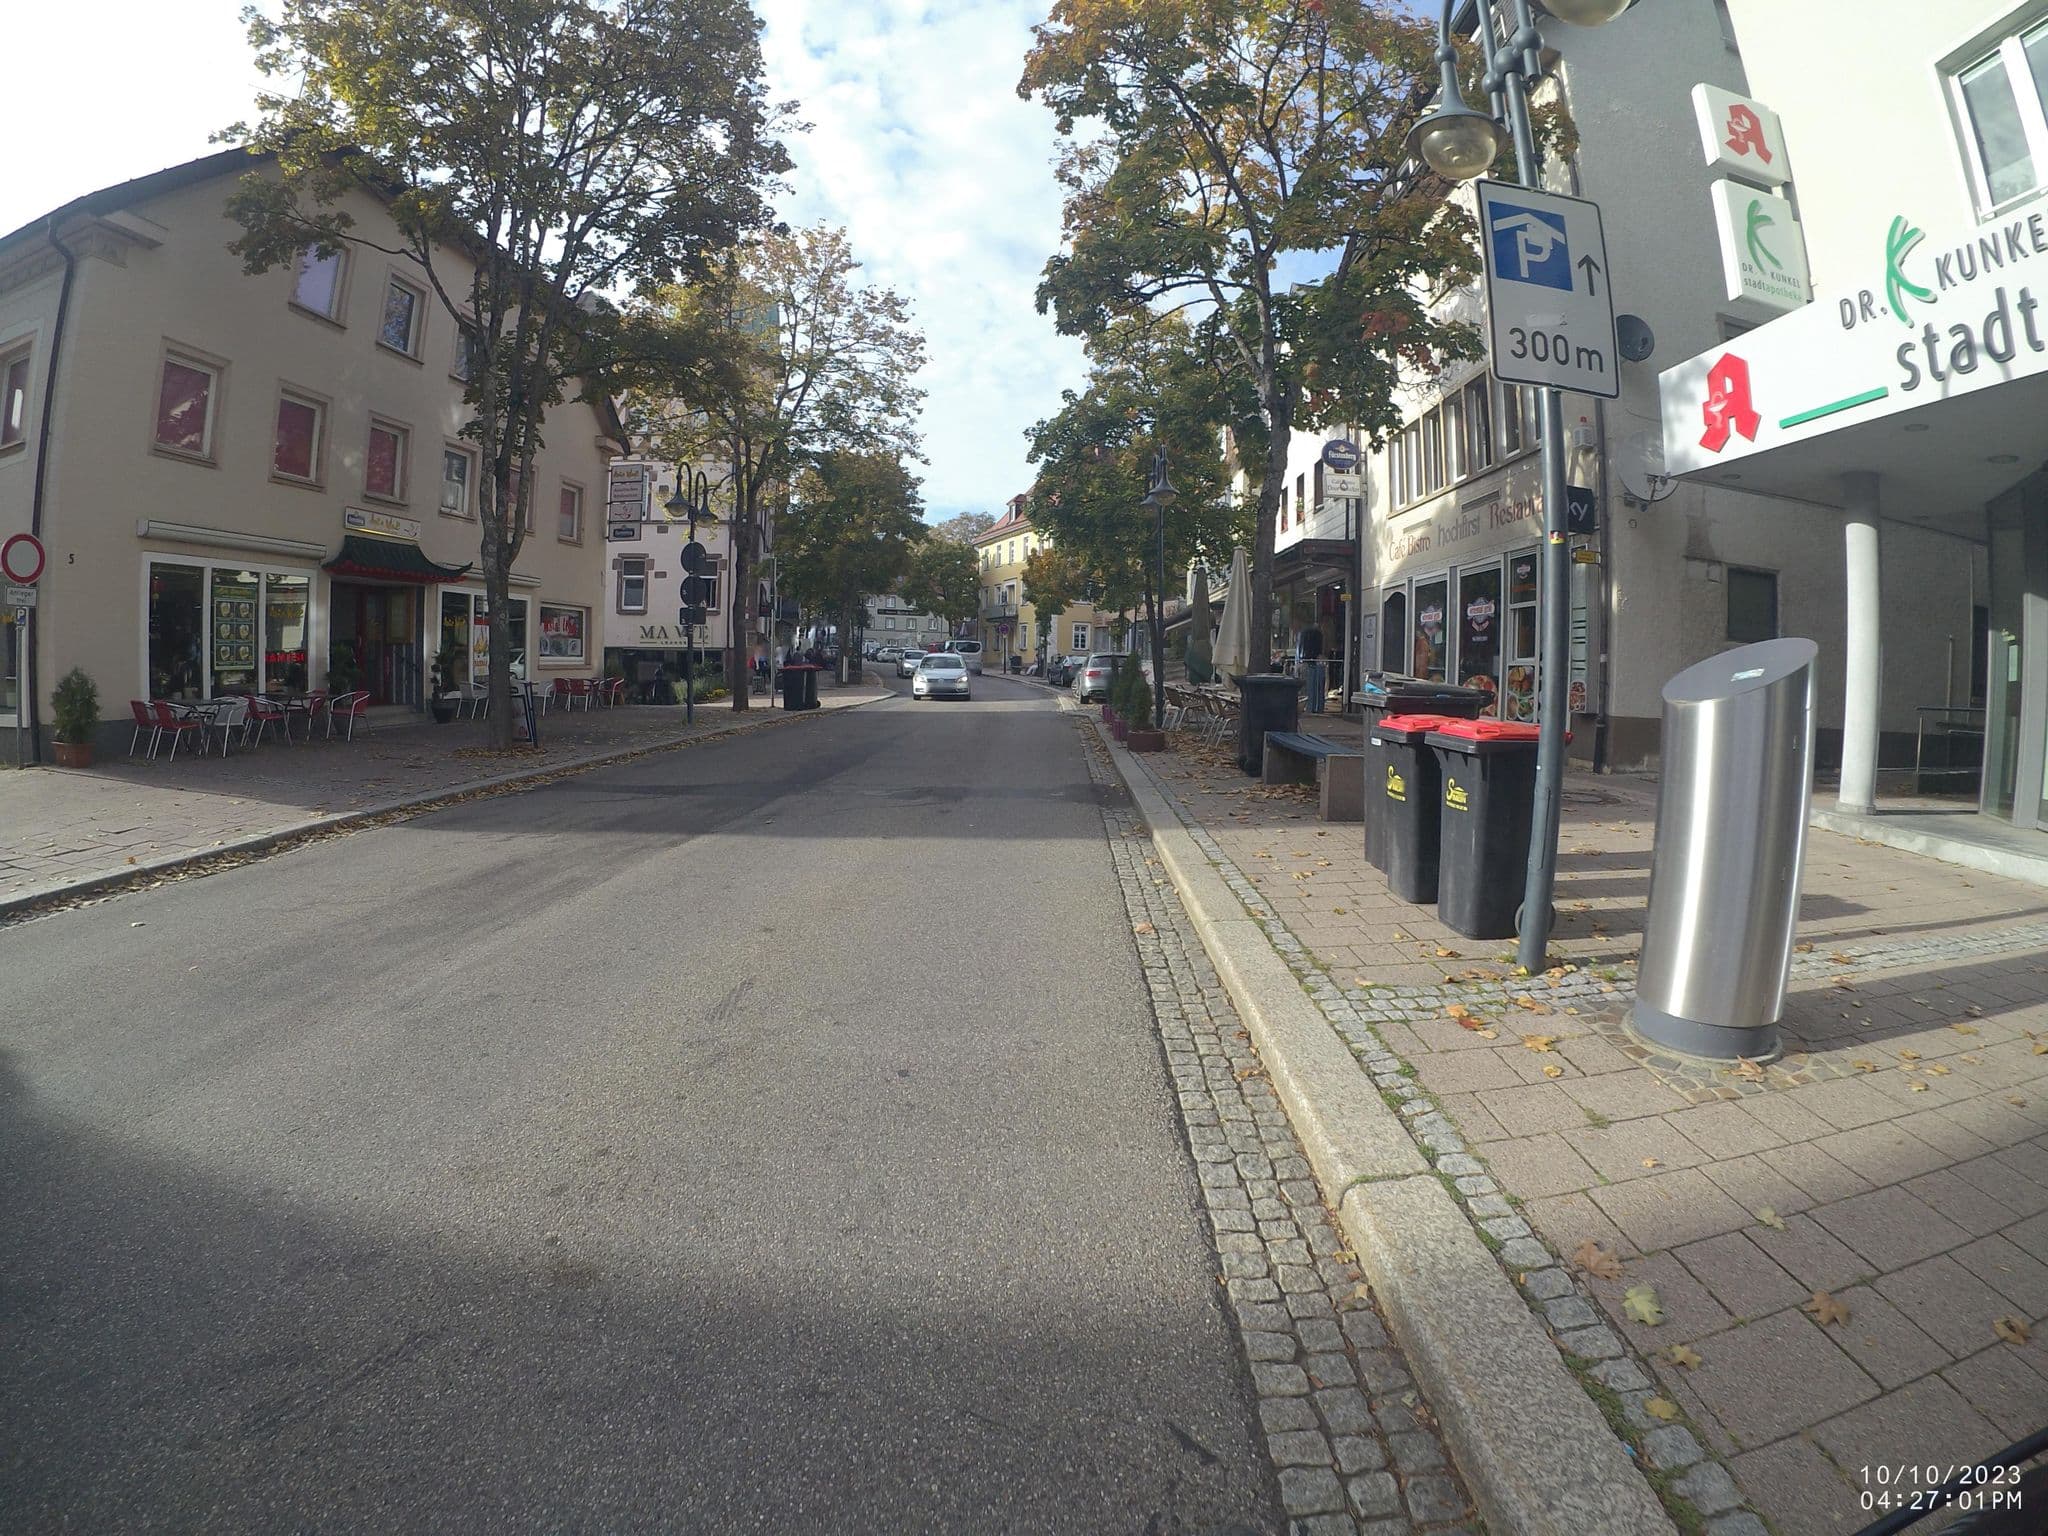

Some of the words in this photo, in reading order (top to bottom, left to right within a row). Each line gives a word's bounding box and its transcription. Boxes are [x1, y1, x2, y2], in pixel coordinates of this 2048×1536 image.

[1743, 277, 1802, 301] stadtapotheke
[1770, 271, 1801, 288] KUNKEL
[1839, 289, 1888, 330] DR.
[1509, 327, 1570, 366] 300
[1576, 346, 1604, 373] m
[1896, 286, 2046, 391] stadt
[68, 553, 75, 565] 5
[639, 625, 669, 639] MA
